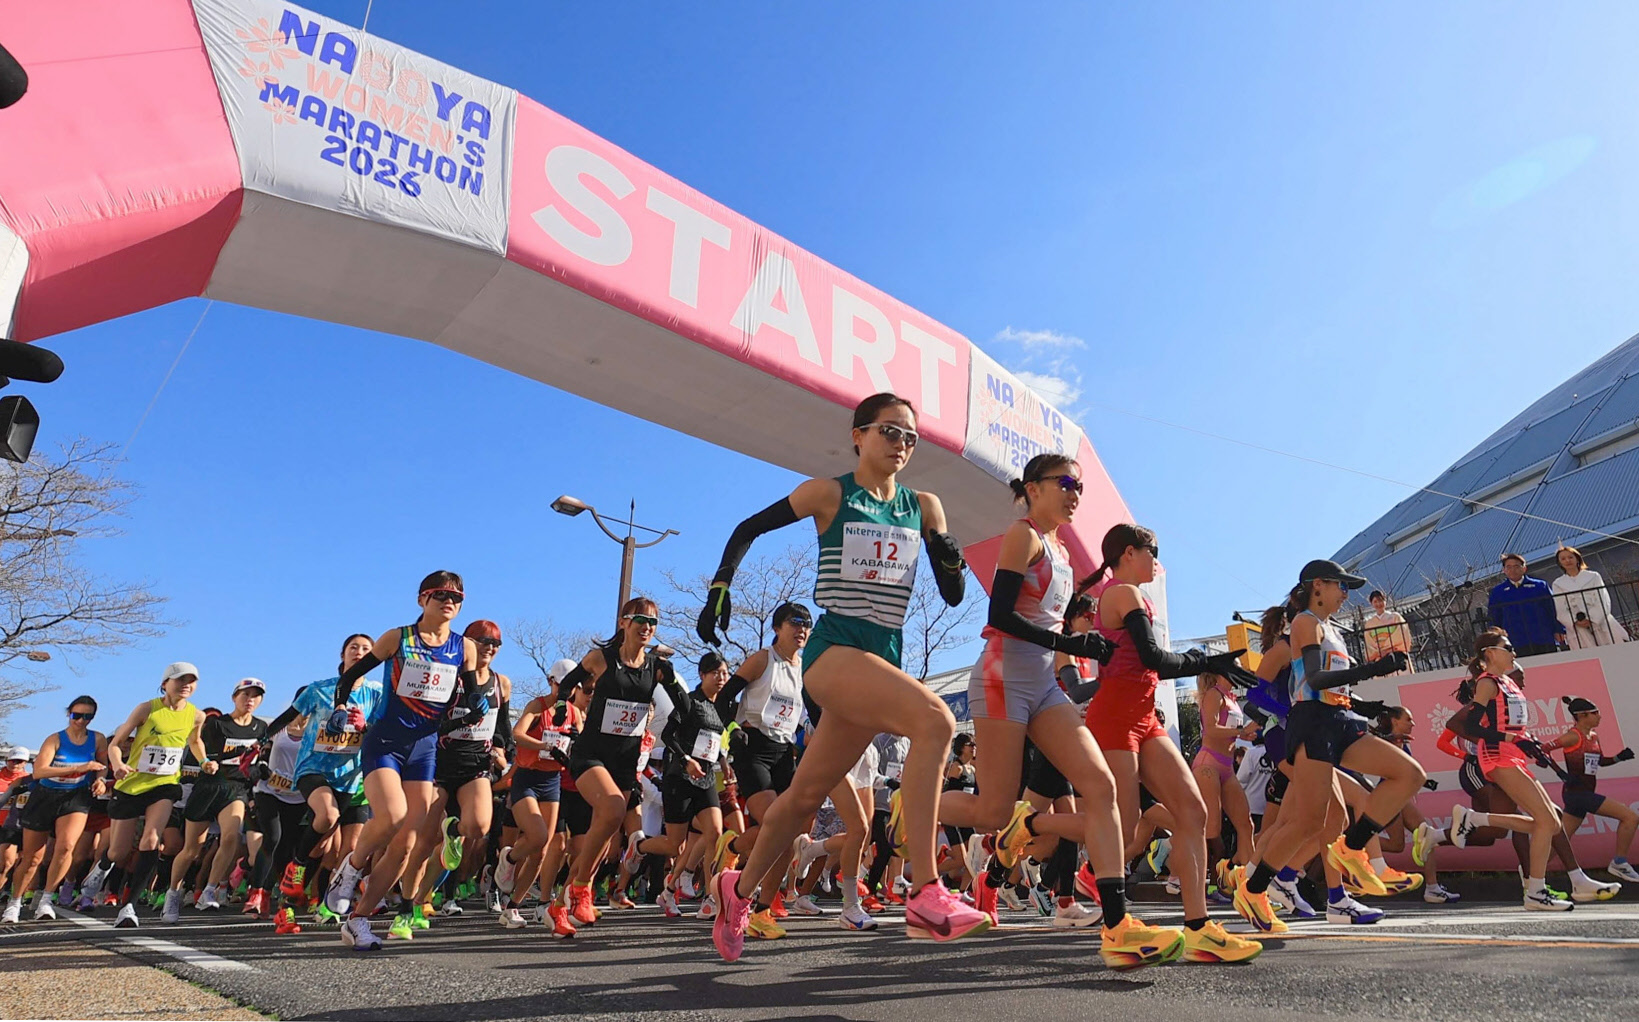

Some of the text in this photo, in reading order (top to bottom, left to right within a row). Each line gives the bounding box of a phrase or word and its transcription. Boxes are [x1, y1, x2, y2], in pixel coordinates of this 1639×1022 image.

[279, 9, 492, 141] NAGOYA
[306, 62, 487, 168] WOMEN'S
[258, 80, 484, 197] MARATHON
[320, 134, 423, 198] 2026
[531, 145, 957, 420] START
[1010, 448, 1029, 472] 20
[845, 526, 882, 538] Niterra
[873, 540, 899, 562] 12
[851, 557, 910, 572] KABASAWA
[405, 660, 431, 671] Niterra
[420, 672, 441, 686] 38
[406, 681, 447, 693] MURAKAMI
[620, 710, 637, 723] 28
[779, 704, 794, 718] 27
[148, 752, 177, 766] 136
